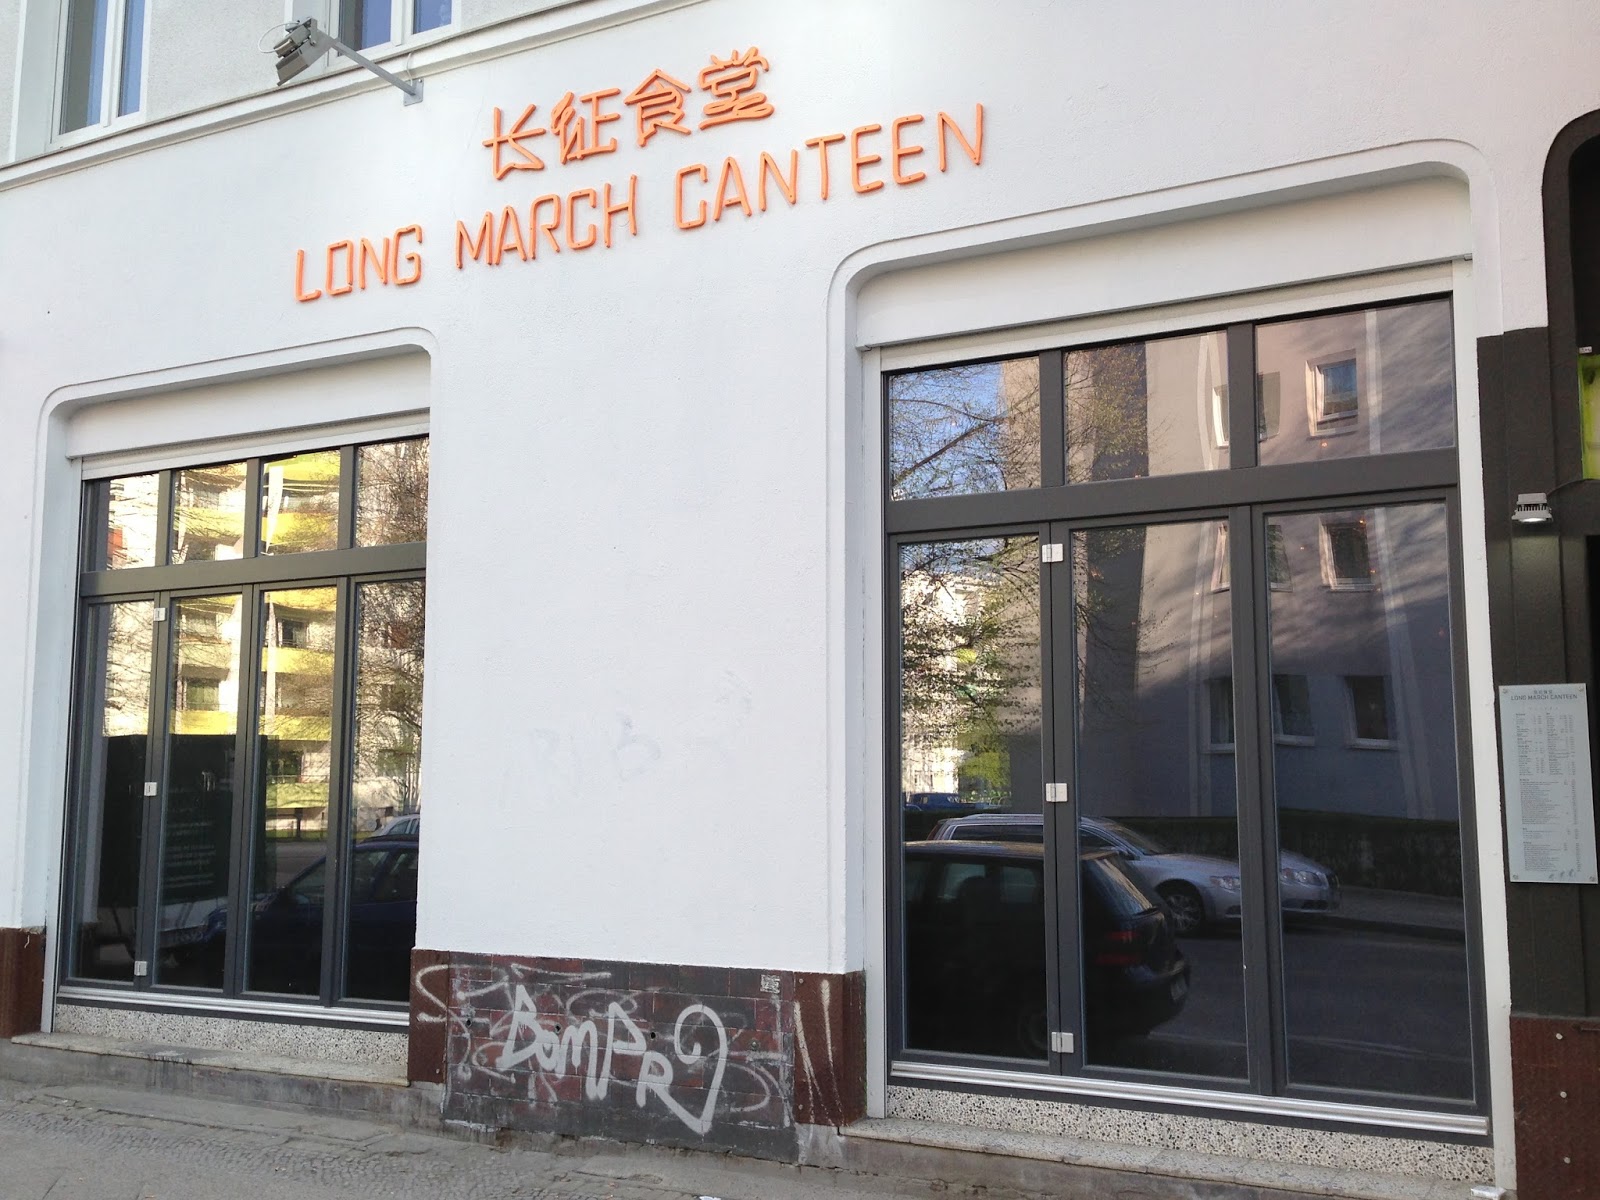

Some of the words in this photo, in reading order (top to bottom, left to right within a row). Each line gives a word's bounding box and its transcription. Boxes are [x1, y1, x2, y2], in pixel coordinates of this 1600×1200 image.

[482, 46, 776, 182] 长征食堂
[295, 224, 423, 303] LONG
[455, 174, 638, 269] MARCH
[674, 102, 984, 231] CANTEEN
